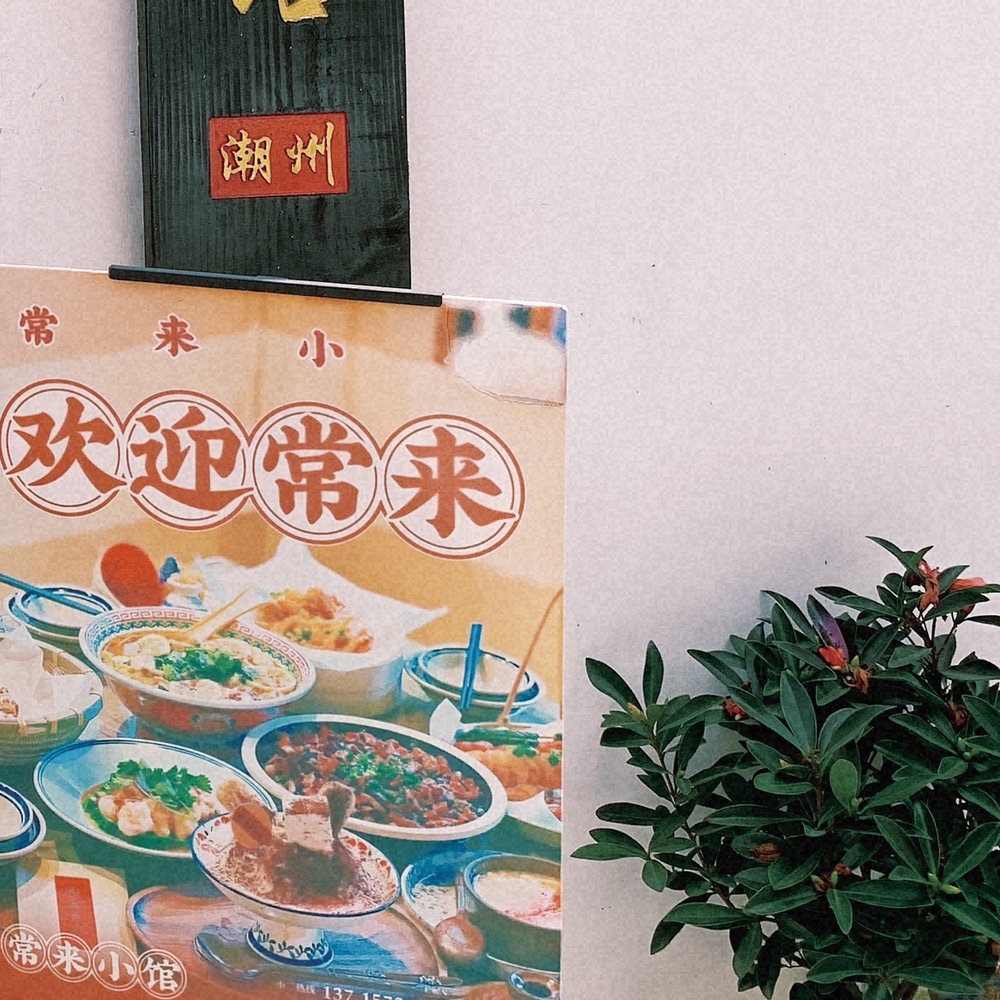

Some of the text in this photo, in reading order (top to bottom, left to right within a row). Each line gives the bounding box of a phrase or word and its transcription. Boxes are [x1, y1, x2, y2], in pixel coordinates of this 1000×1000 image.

[220, 121, 337, 186] 潮州
[5, 396, 517, 540] 欢迎常来
[8, 932, 182, 993] 常来小馆
